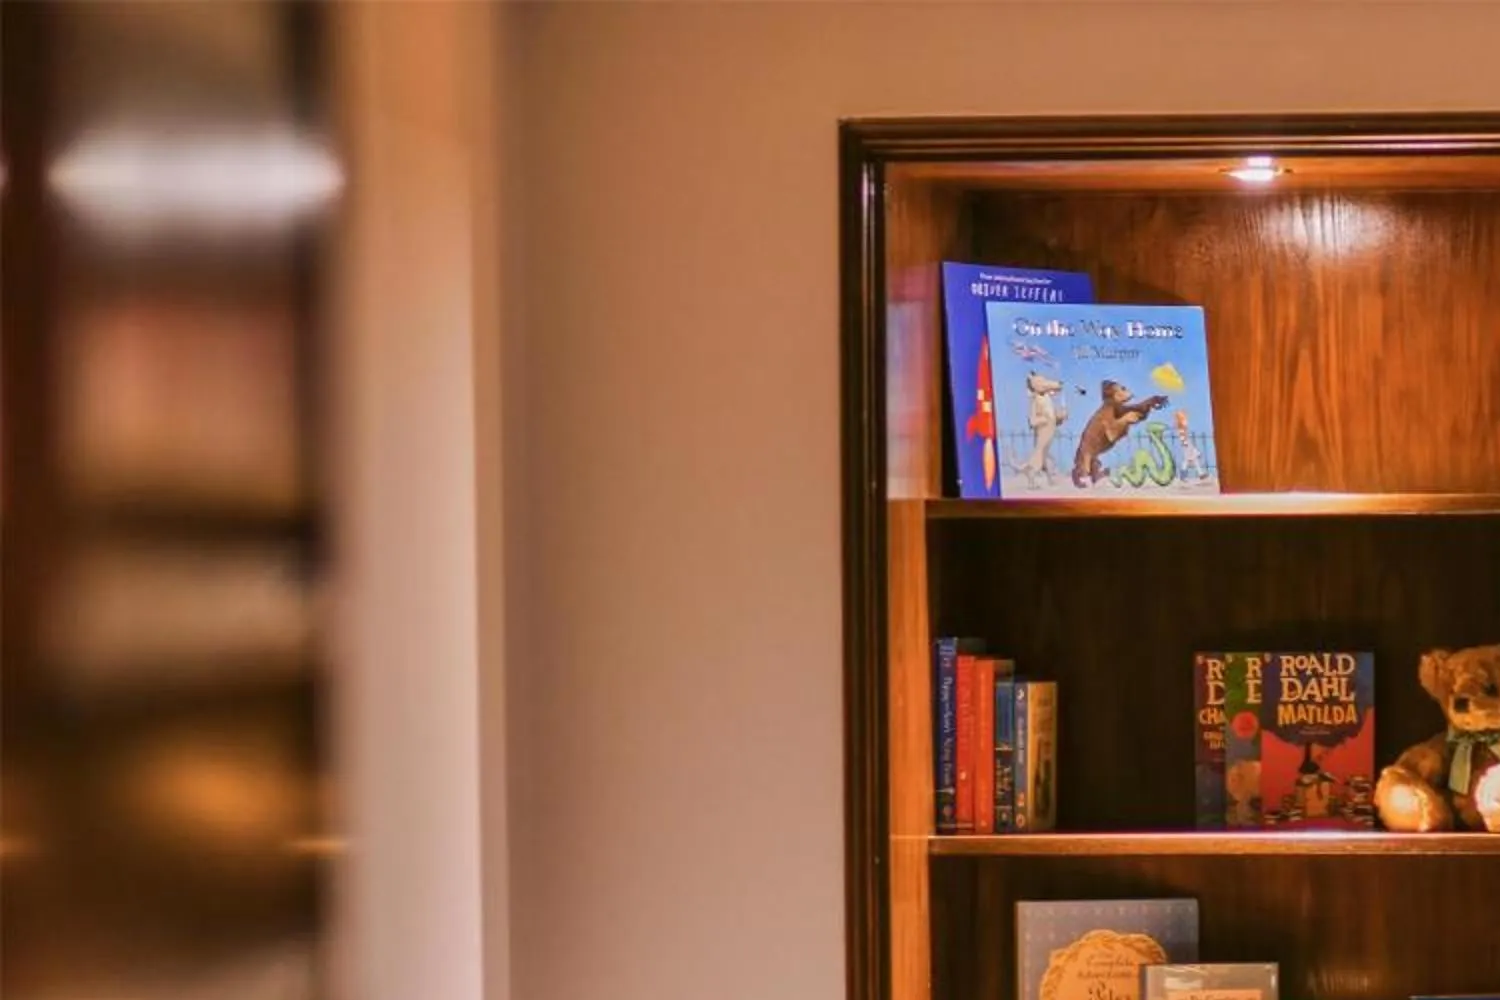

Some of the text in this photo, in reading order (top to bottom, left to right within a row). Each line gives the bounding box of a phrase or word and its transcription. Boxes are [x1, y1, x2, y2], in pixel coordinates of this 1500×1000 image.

[1126, 319, 1184, 340] Home
[1279, 653, 1356, 677] ROALD
[1279, 676, 1356, 702] DAHL
[1276, 703, 1358, 727] MATILDA
